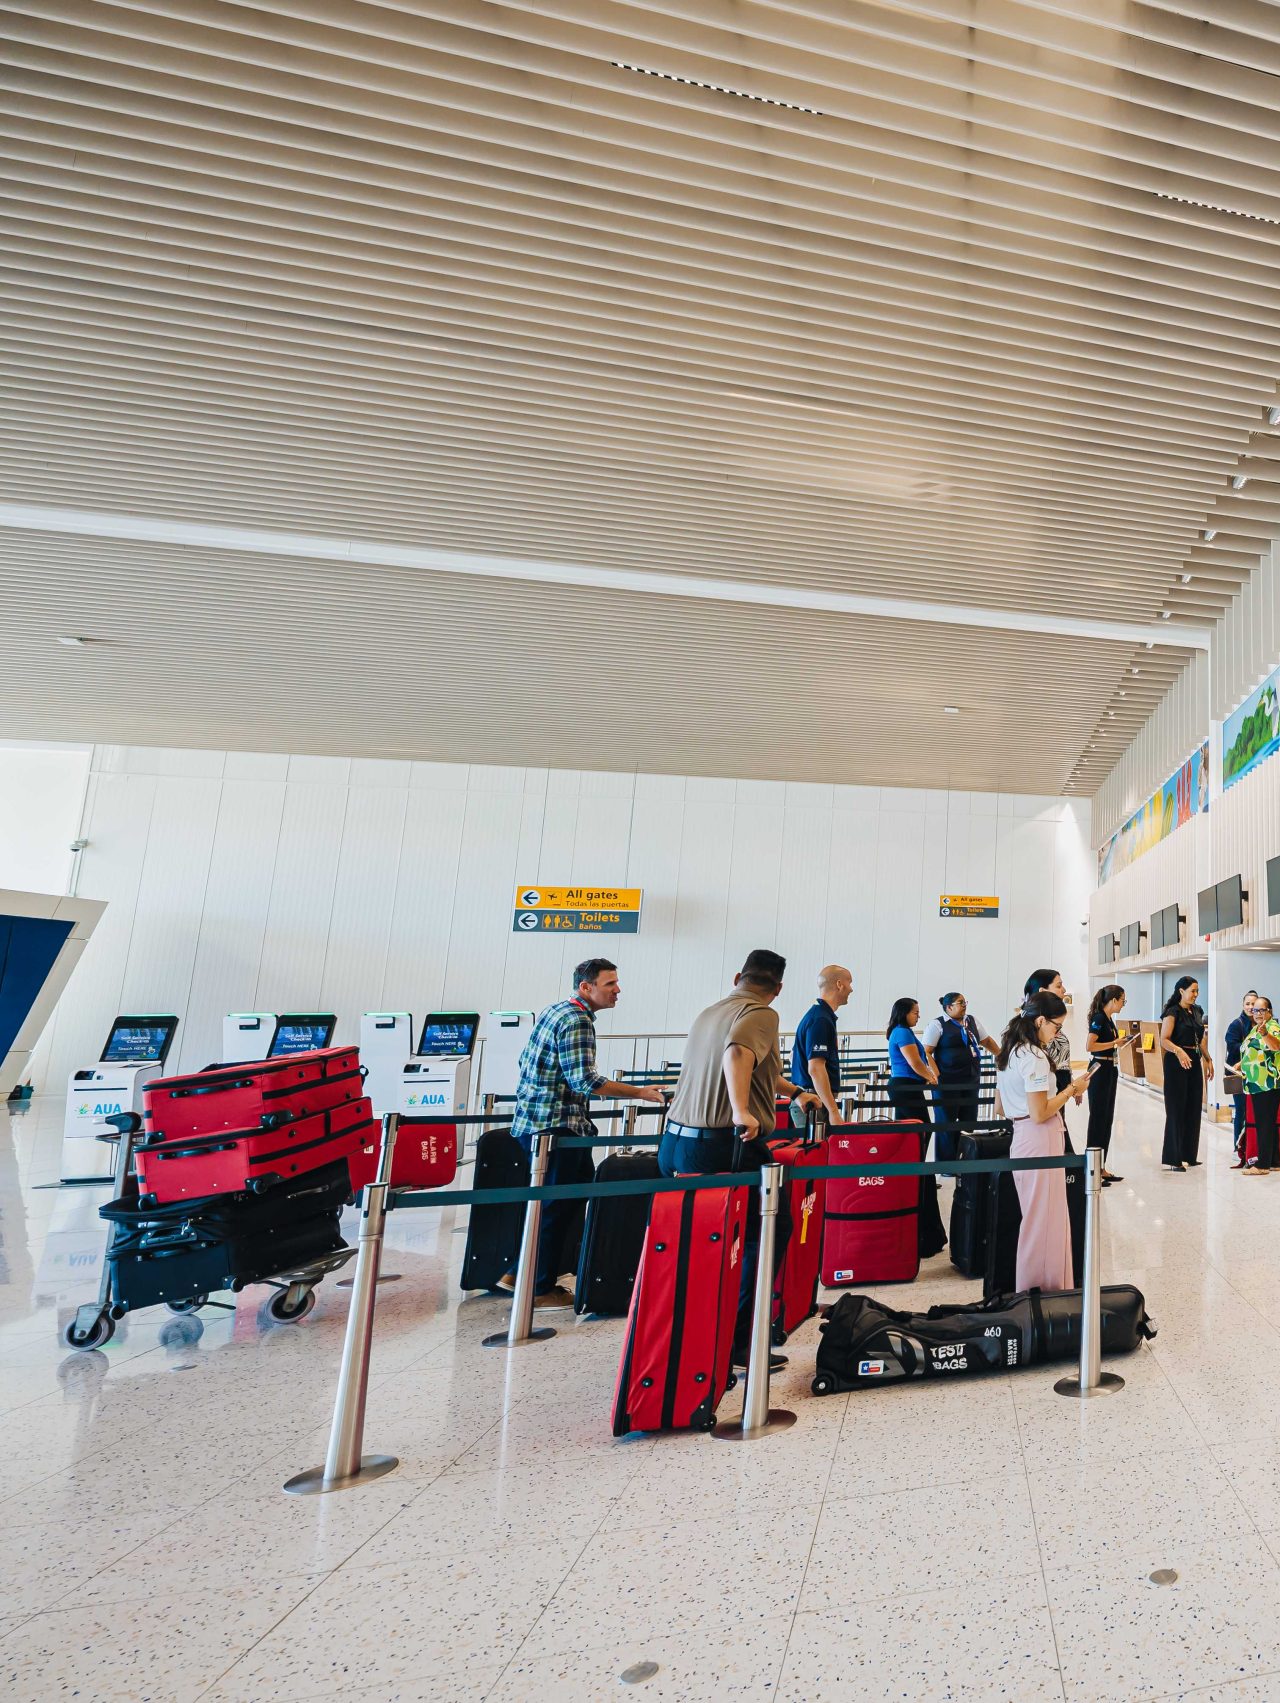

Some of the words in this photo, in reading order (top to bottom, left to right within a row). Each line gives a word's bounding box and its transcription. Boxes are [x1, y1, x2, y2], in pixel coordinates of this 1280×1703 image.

[566, 890, 582, 899] All
[586, 891, 618, 900] gates
[580, 913, 620, 922] Toilets
[421, 1094, 445, 1105] AUA
[94, 1104, 122, 1114] AUA
[838, 1140, 850, 1149] 102
[421, 1141, 429, 1160] BAGS
[858, 1176, 885, 1186] BAGS
[1065, 1174, 1075, 1184] 60
[984, 1326, 1001, 1338] 460
[930, 1343, 966, 1359] TEST
[932, 1357, 968, 1370] BAGS
